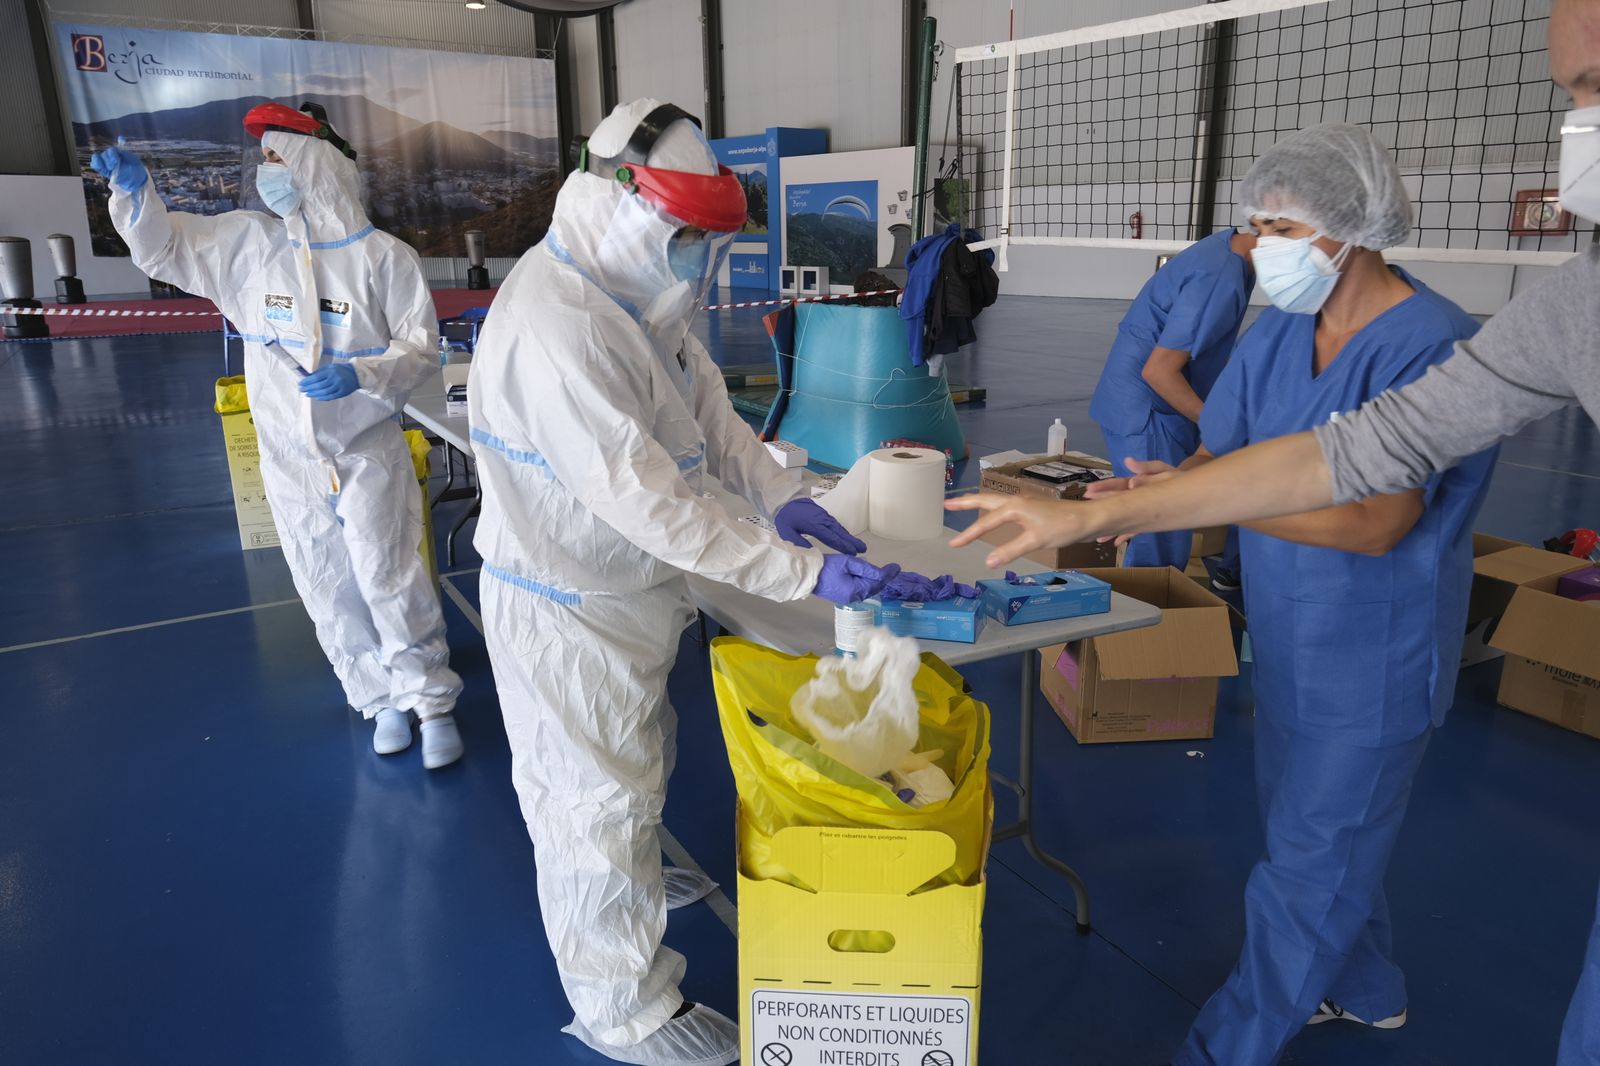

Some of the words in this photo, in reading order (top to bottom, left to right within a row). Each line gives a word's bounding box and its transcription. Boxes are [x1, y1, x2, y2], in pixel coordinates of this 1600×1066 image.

[757, 1000, 861, 1021] PERFORANTS
[866, 1006, 885, 1021] ET
[890, 1007, 964, 1024] LIQUIDES
[778, 1025, 814, 1041] NON
[819, 1027, 943, 1046] CONDITIONNÉS
[819, 1050, 900, 1066] INTERDITS
